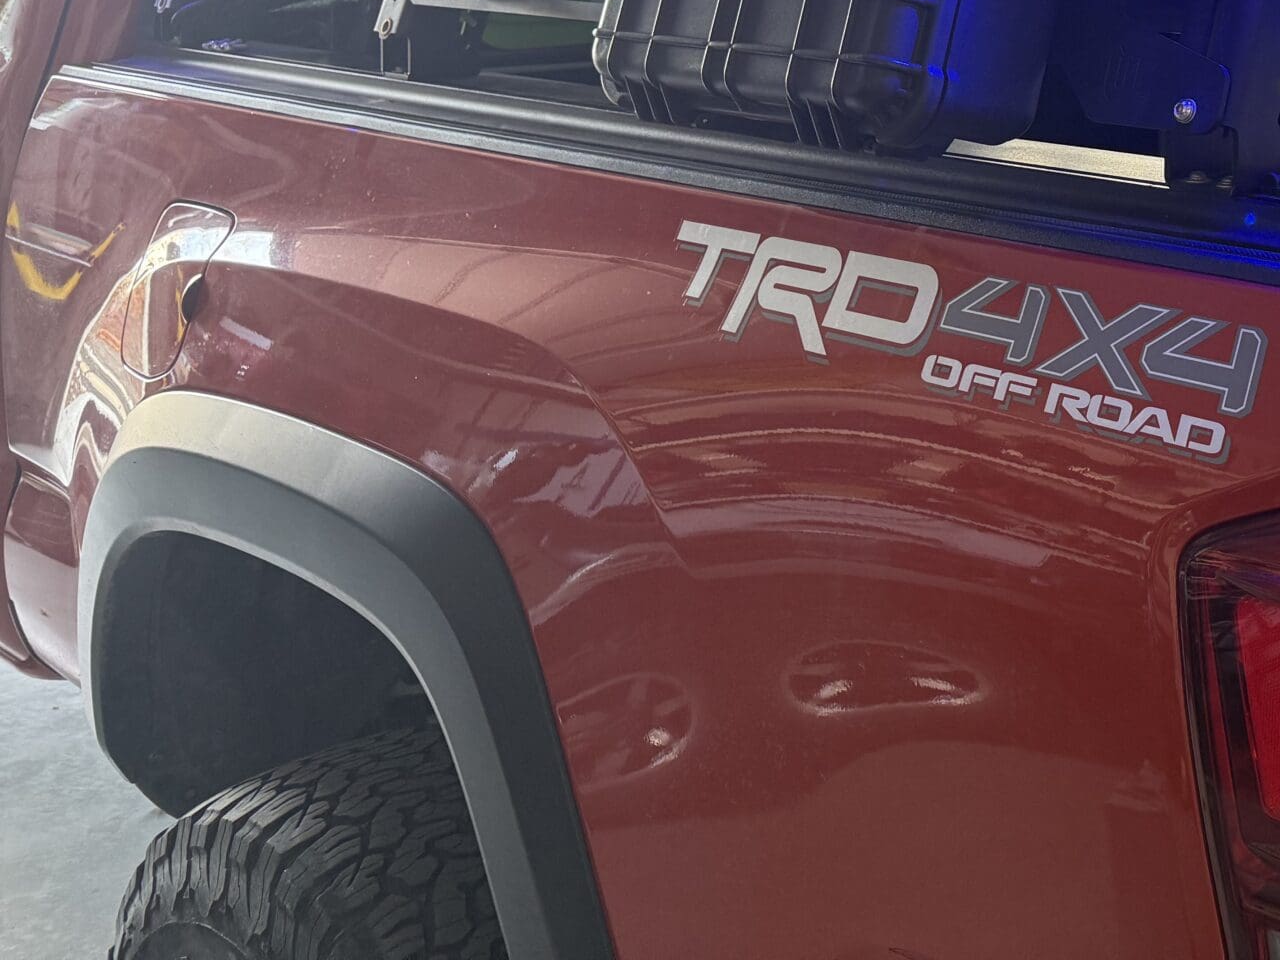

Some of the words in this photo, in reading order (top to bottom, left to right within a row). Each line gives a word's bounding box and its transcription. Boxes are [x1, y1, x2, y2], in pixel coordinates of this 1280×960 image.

[676, 219, 941, 360] TRD
[938, 276, 1268, 418] 4X4
[920, 354, 1039, 408] OFF
[1043, 383, 1230, 461] ROAD
